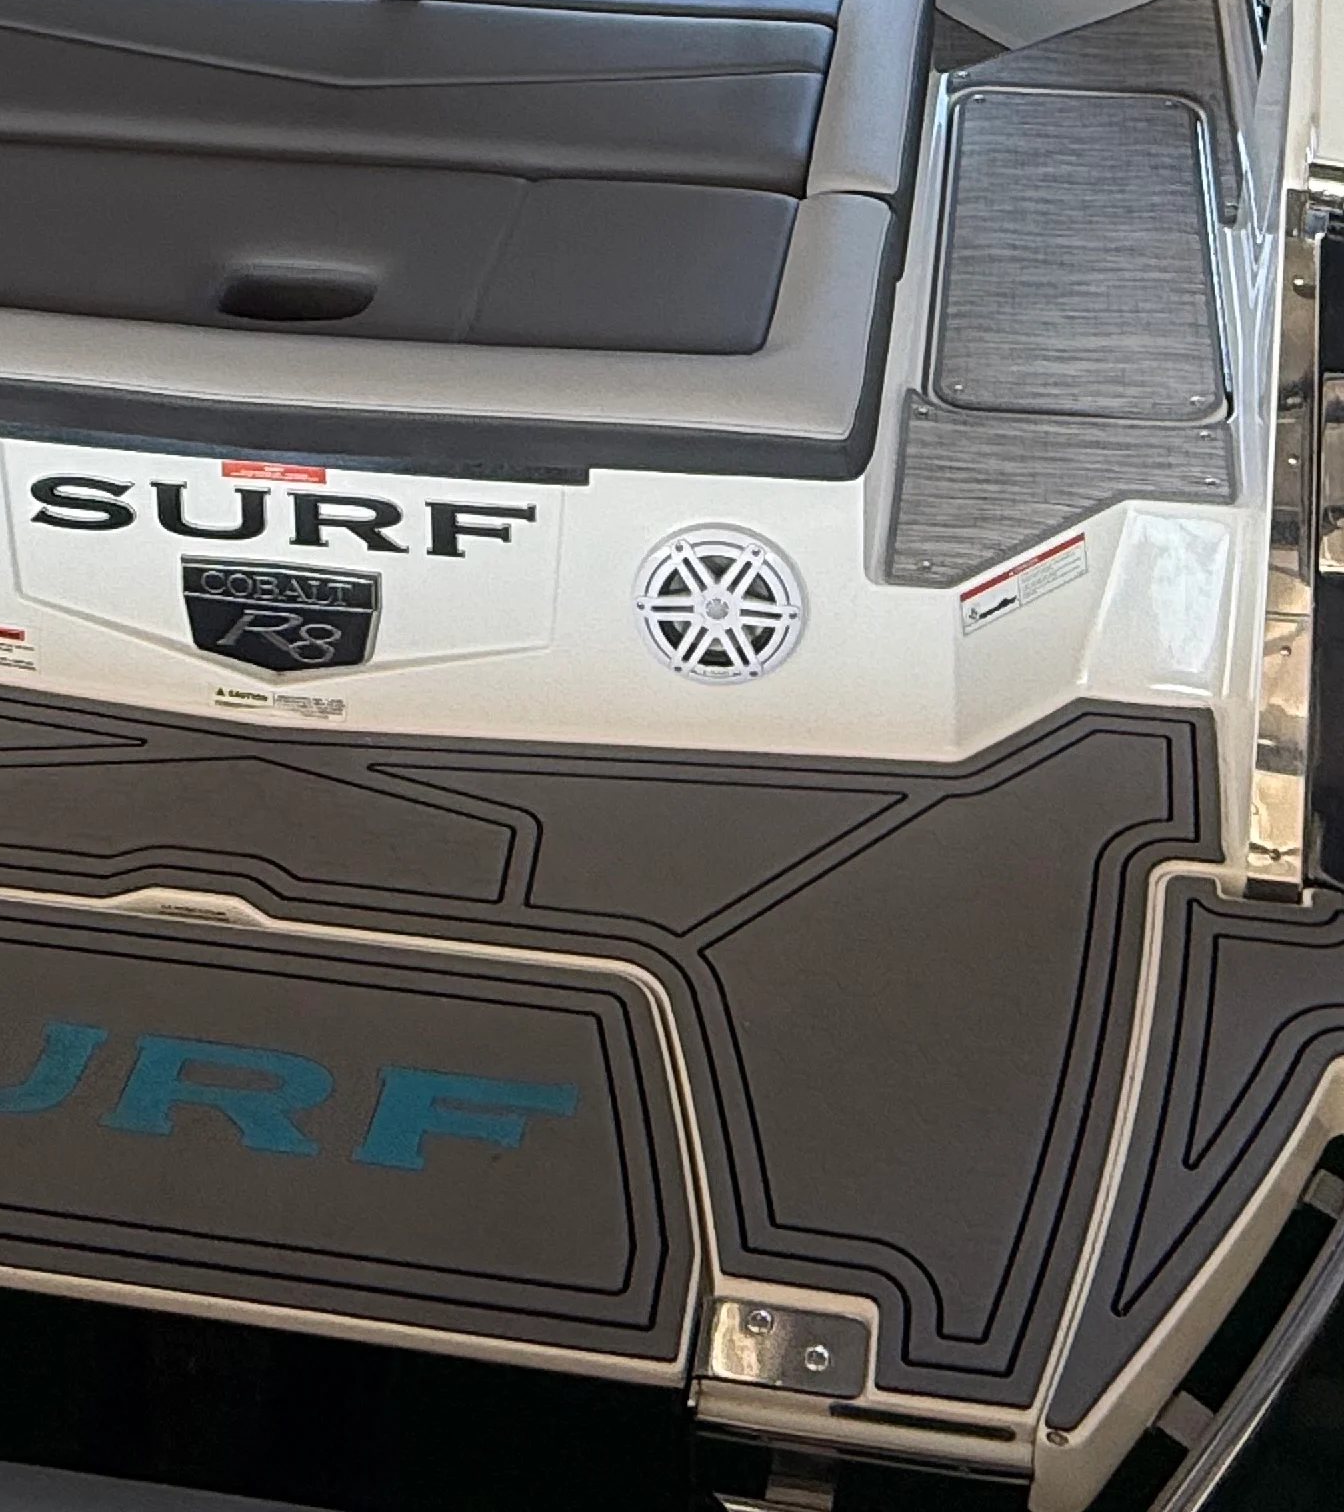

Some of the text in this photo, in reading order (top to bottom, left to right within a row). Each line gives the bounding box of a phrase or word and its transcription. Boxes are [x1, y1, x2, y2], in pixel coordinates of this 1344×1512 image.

[30, 472, 538, 558] SURF
[201, 570, 352, 606] COBALT
[216, 608, 342, 664] R8
